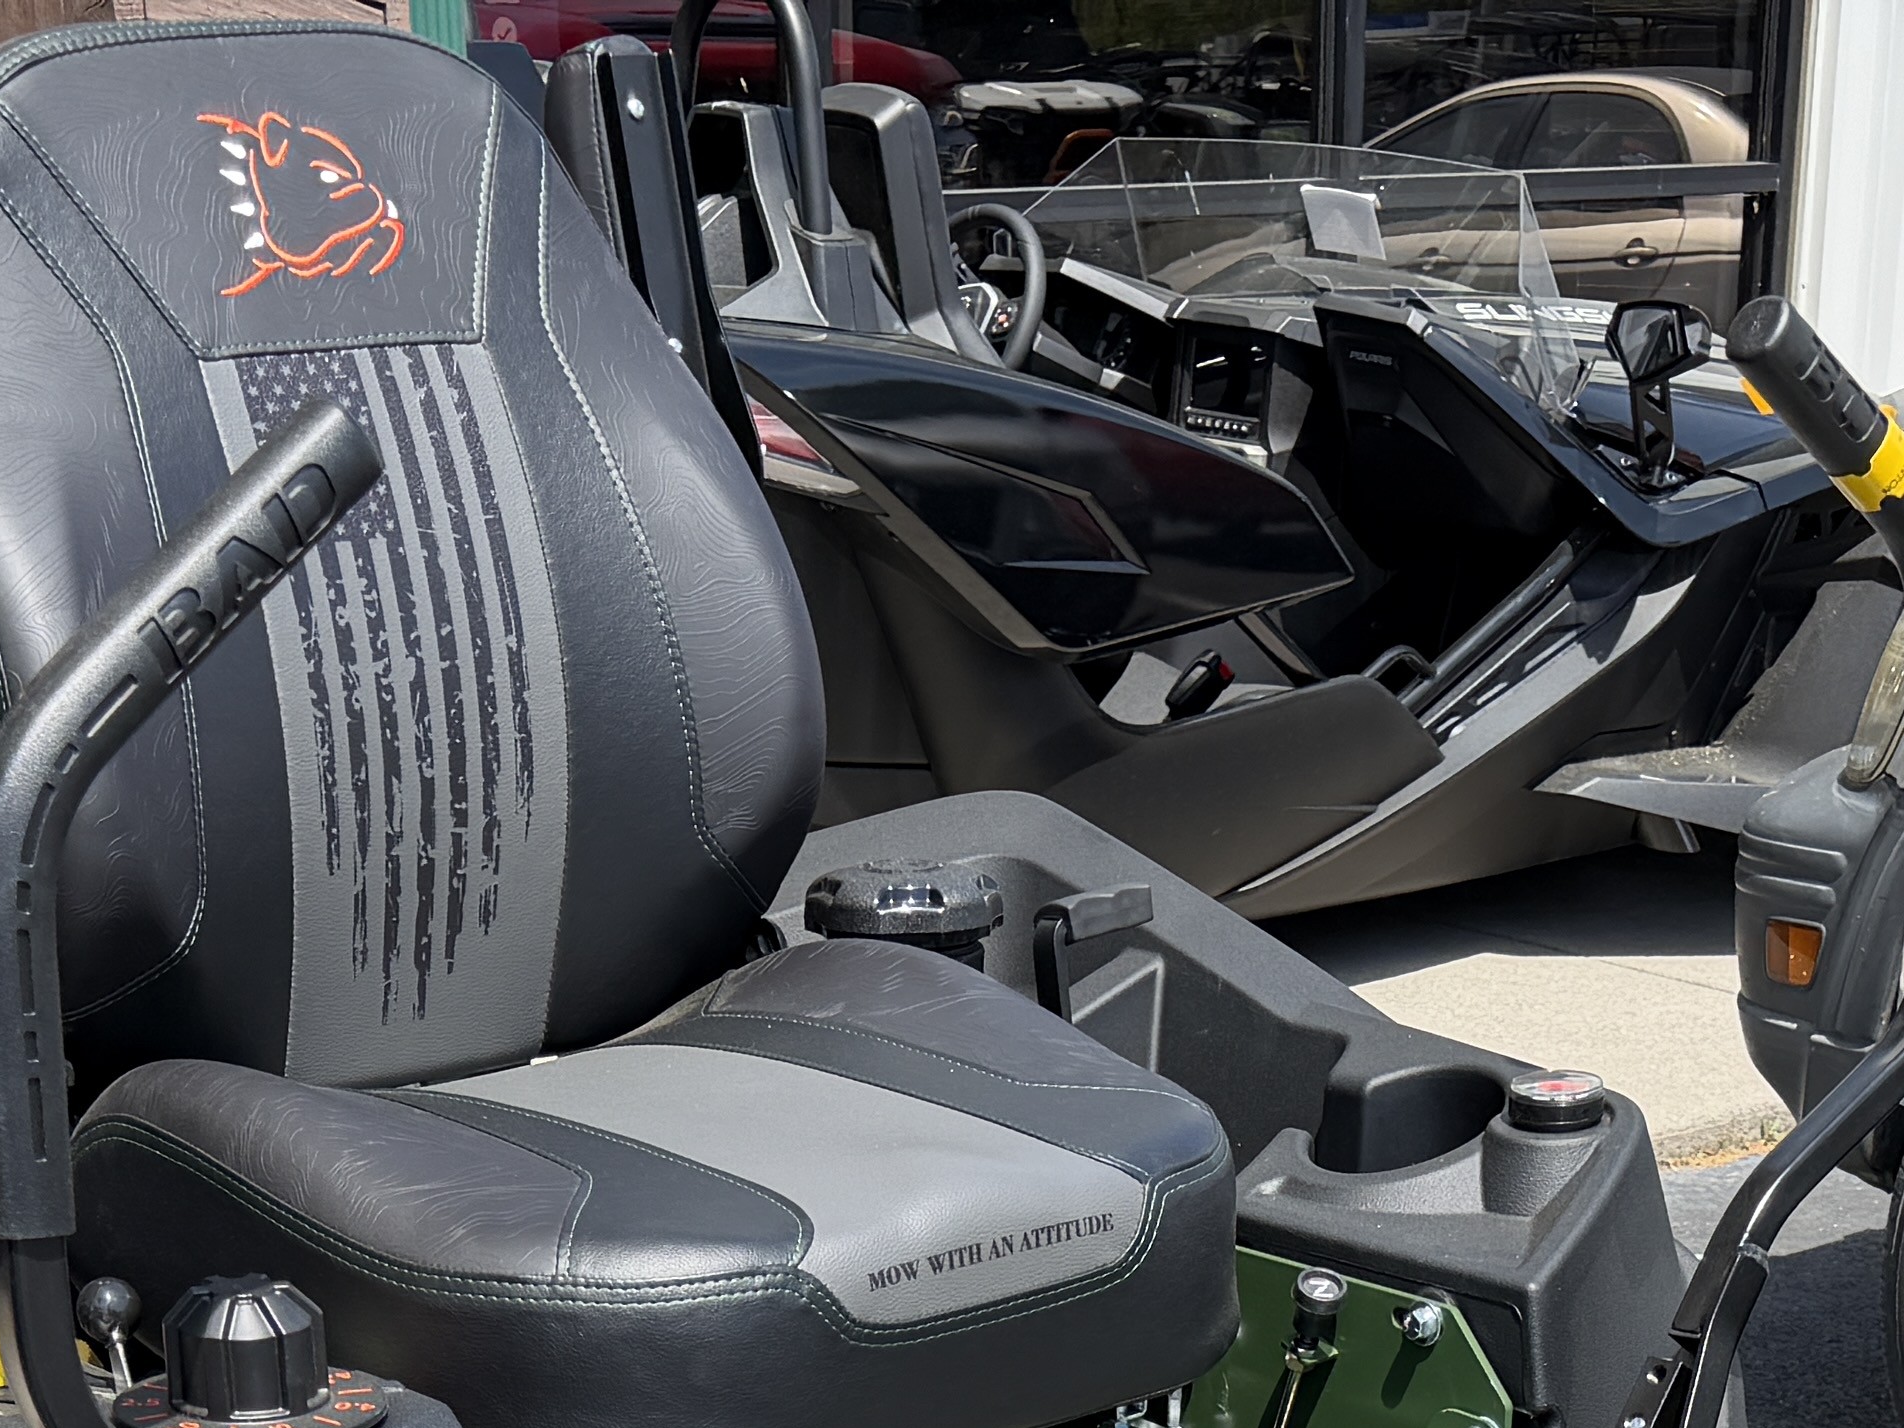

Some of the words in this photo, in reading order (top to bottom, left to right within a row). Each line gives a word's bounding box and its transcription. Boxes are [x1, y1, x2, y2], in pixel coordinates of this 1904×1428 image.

[136, 462, 336, 686] BAD
[867, 1259, 921, 1293] MOW
[926, 1242, 983, 1276] WITH
[988, 1234, 1015, 1261] AN
[1019, 1212, 1115, 1252] ATTITUDE
